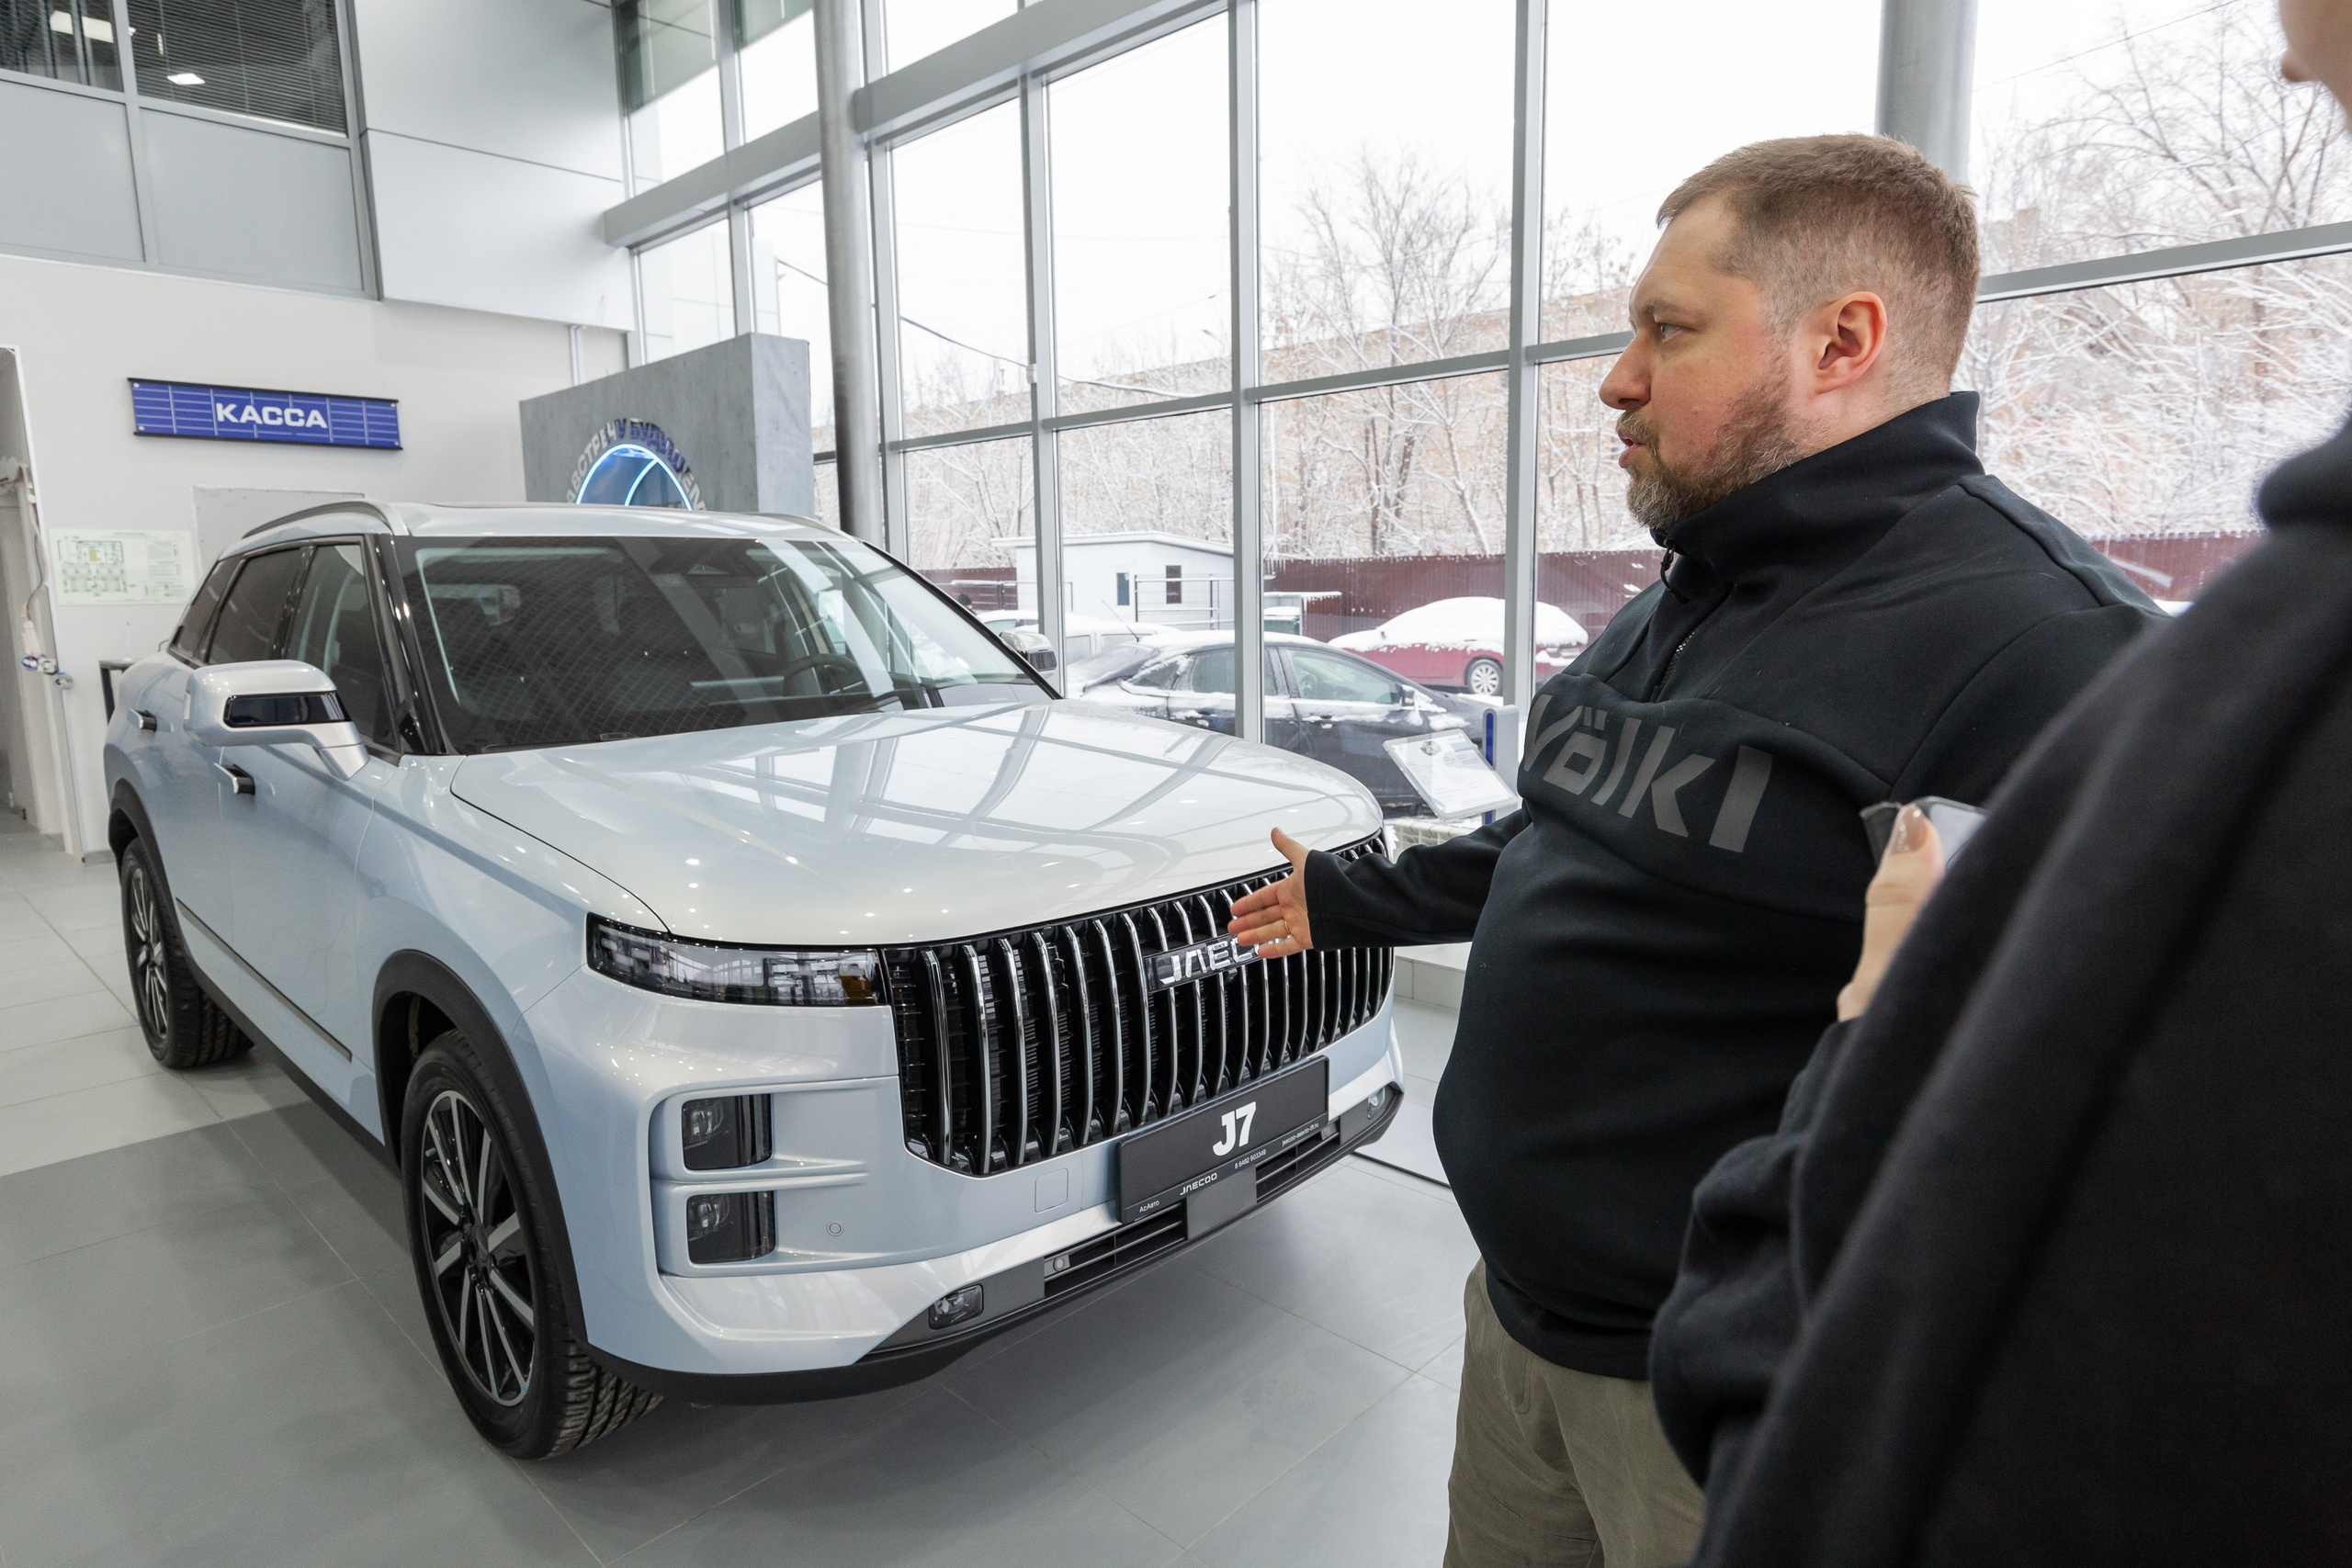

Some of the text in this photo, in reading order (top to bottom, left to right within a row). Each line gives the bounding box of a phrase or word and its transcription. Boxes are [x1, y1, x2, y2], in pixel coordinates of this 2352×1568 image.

[216, 402, 328, 429] КАССА
[566, 418, 707, 512] АВСТРЕЧУ БУДУЩЕМ
[1159, 937, 1260, 986] JAEC
[1212, 1101, 1257, 1156] J7
[1179, 1172, 1218, 1196] JAECOO
